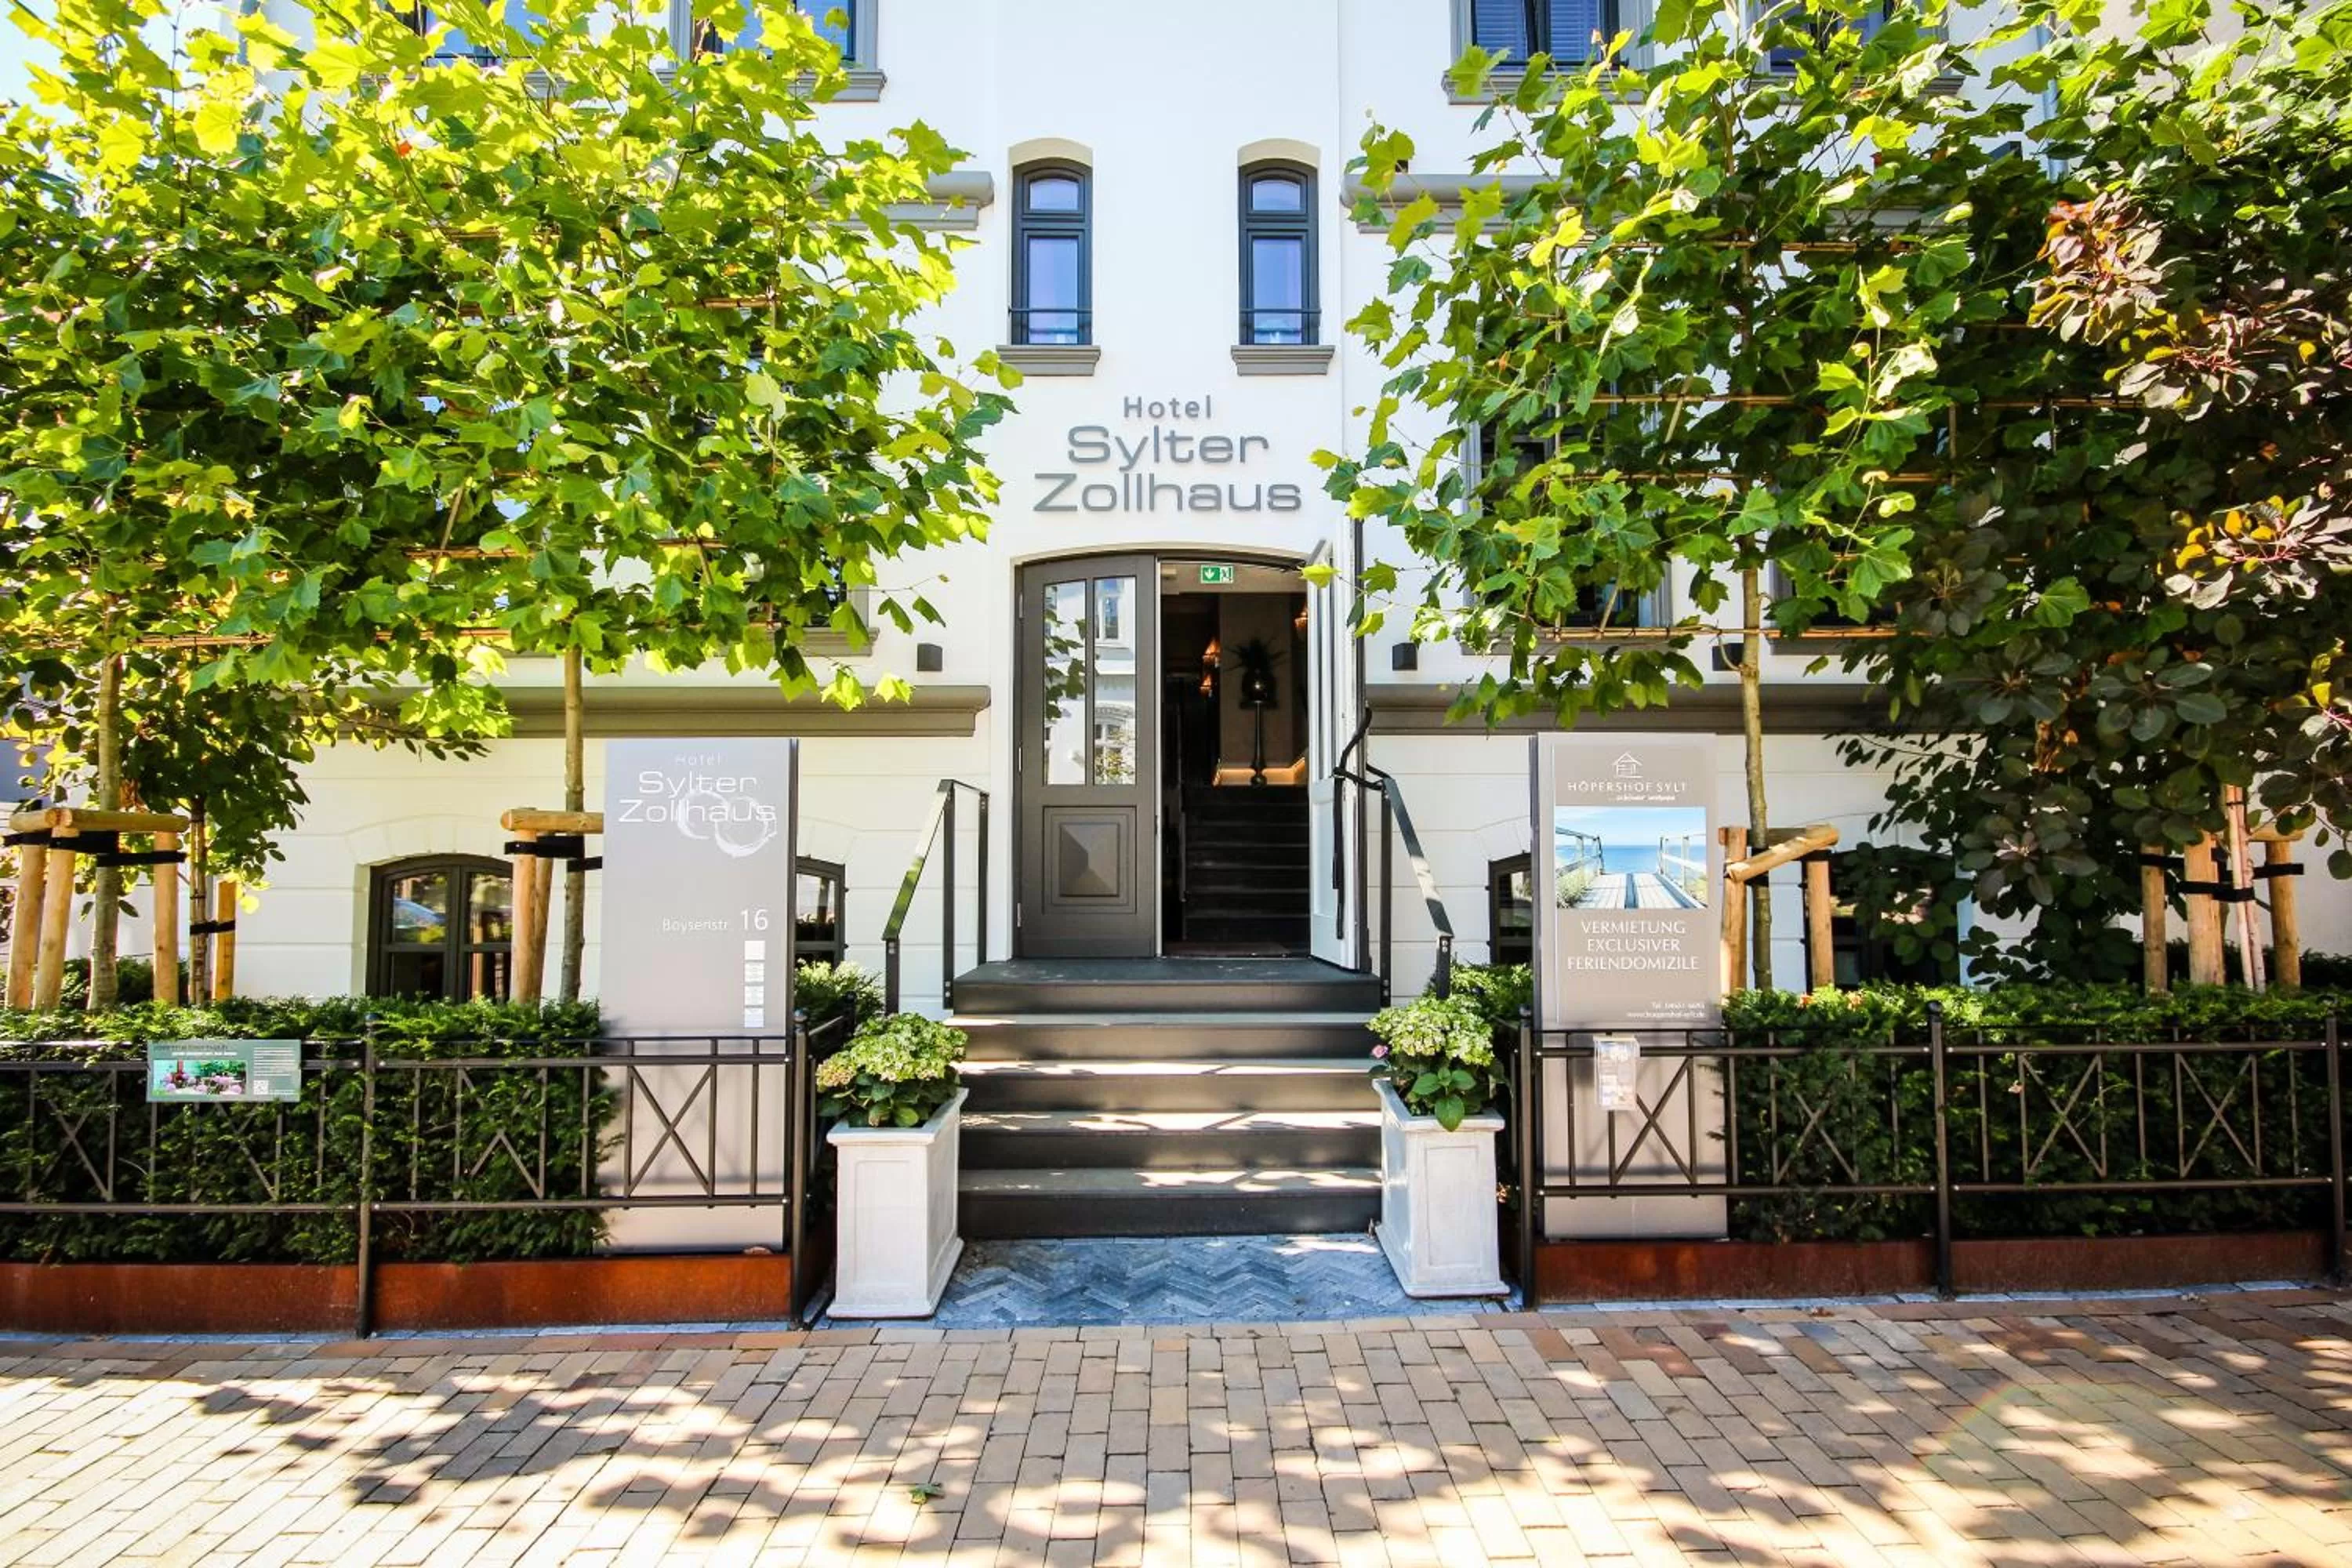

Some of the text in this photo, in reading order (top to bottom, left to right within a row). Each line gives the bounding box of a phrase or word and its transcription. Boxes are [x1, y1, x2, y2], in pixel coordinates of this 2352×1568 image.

[1123, 395, 1211, 419] Hotel
[1067, 425, 1269, 471] Sylter
[1033, 473, 1301, 512] Zollhaus
[674, 752, 720, 765] Hotel
[639, 771, 758, 798] Sylter
[1656, 782, 1686, 792] SYLT
[619, 800, 777, 822] Zollhaus
[740, 909, 769, 931] 16
[1581, 920, 1686, 934] VERMIETUNG
[1588, 938, 1680, 952] EXCLUSIVER
[1568, 956, 1700, 970] FERIENDOMIZILE
